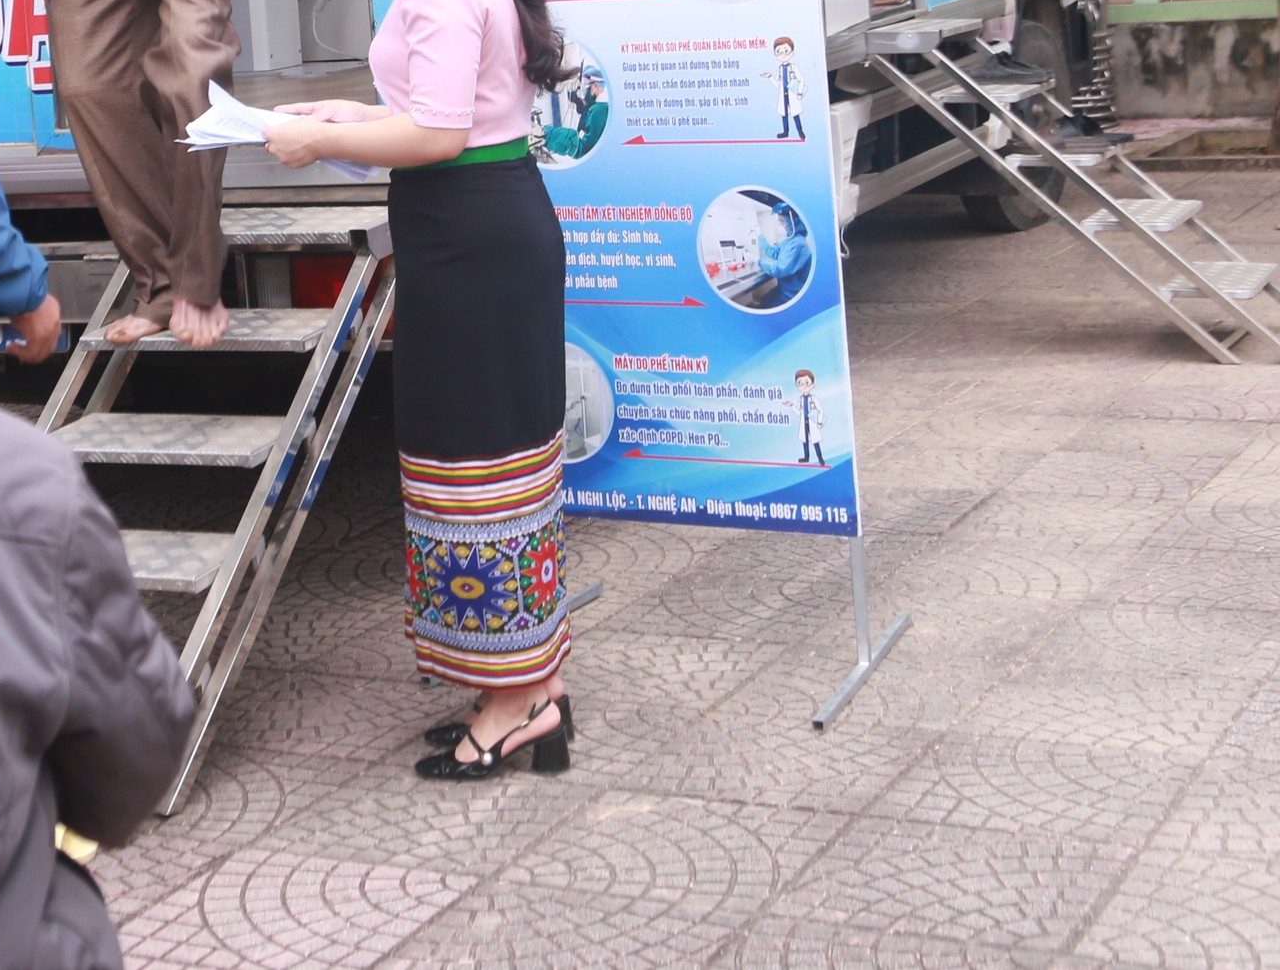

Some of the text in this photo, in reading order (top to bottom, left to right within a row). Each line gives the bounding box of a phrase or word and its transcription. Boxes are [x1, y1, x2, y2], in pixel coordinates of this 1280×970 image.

[665, 42, 677, 52] SOI
[581, 203, 599, 221] TÂM
[619, 204, 652, 225] NGHIỆM
[680, 205, 693, 224] BỘ
[622, 230, 641, 244] Sinh
[578, 252, 599, 268] dịch,
[600, 250, 624, 268] huyết
[645, 254, 654, 266] vi
[655, 253, 677, 268] sinh,
[597, 274, 618, 291] bệnh
[614, 355, 634, 371] MÁY
[636, 358, 648, 371] DO
[650, 355, 668, 372] PHẾ
[670, 357, 694, 372] THÂN
[616, 381, 628, 395] Đo
[630, 382, 651, 396] dung
[653, 381, 670, 396] tích
[672, 380, 692, 398] phổi
[694, 383, 714, 397] toàn
[743, 384, 765, 400] đánh
[767, 384, 783, 401] giá
[618, 405, 650, 421] chuyên
[651, 406, 668, 419] sâu
[669, 407, 691, 421] chức
[693, 408, 716, 423] năng
[767, 410, 790, 425] đoán
[619, 429, 636, 442] xác
[638, 429, 657, 445] định
[659, 431, 687, 445] COPD,
[688, 433, 705, 445] Hen
[561, 487, 848, 524] XÃ NGHI LỘC T. NGHỆ AN Điện thoại: 0867 995 115
